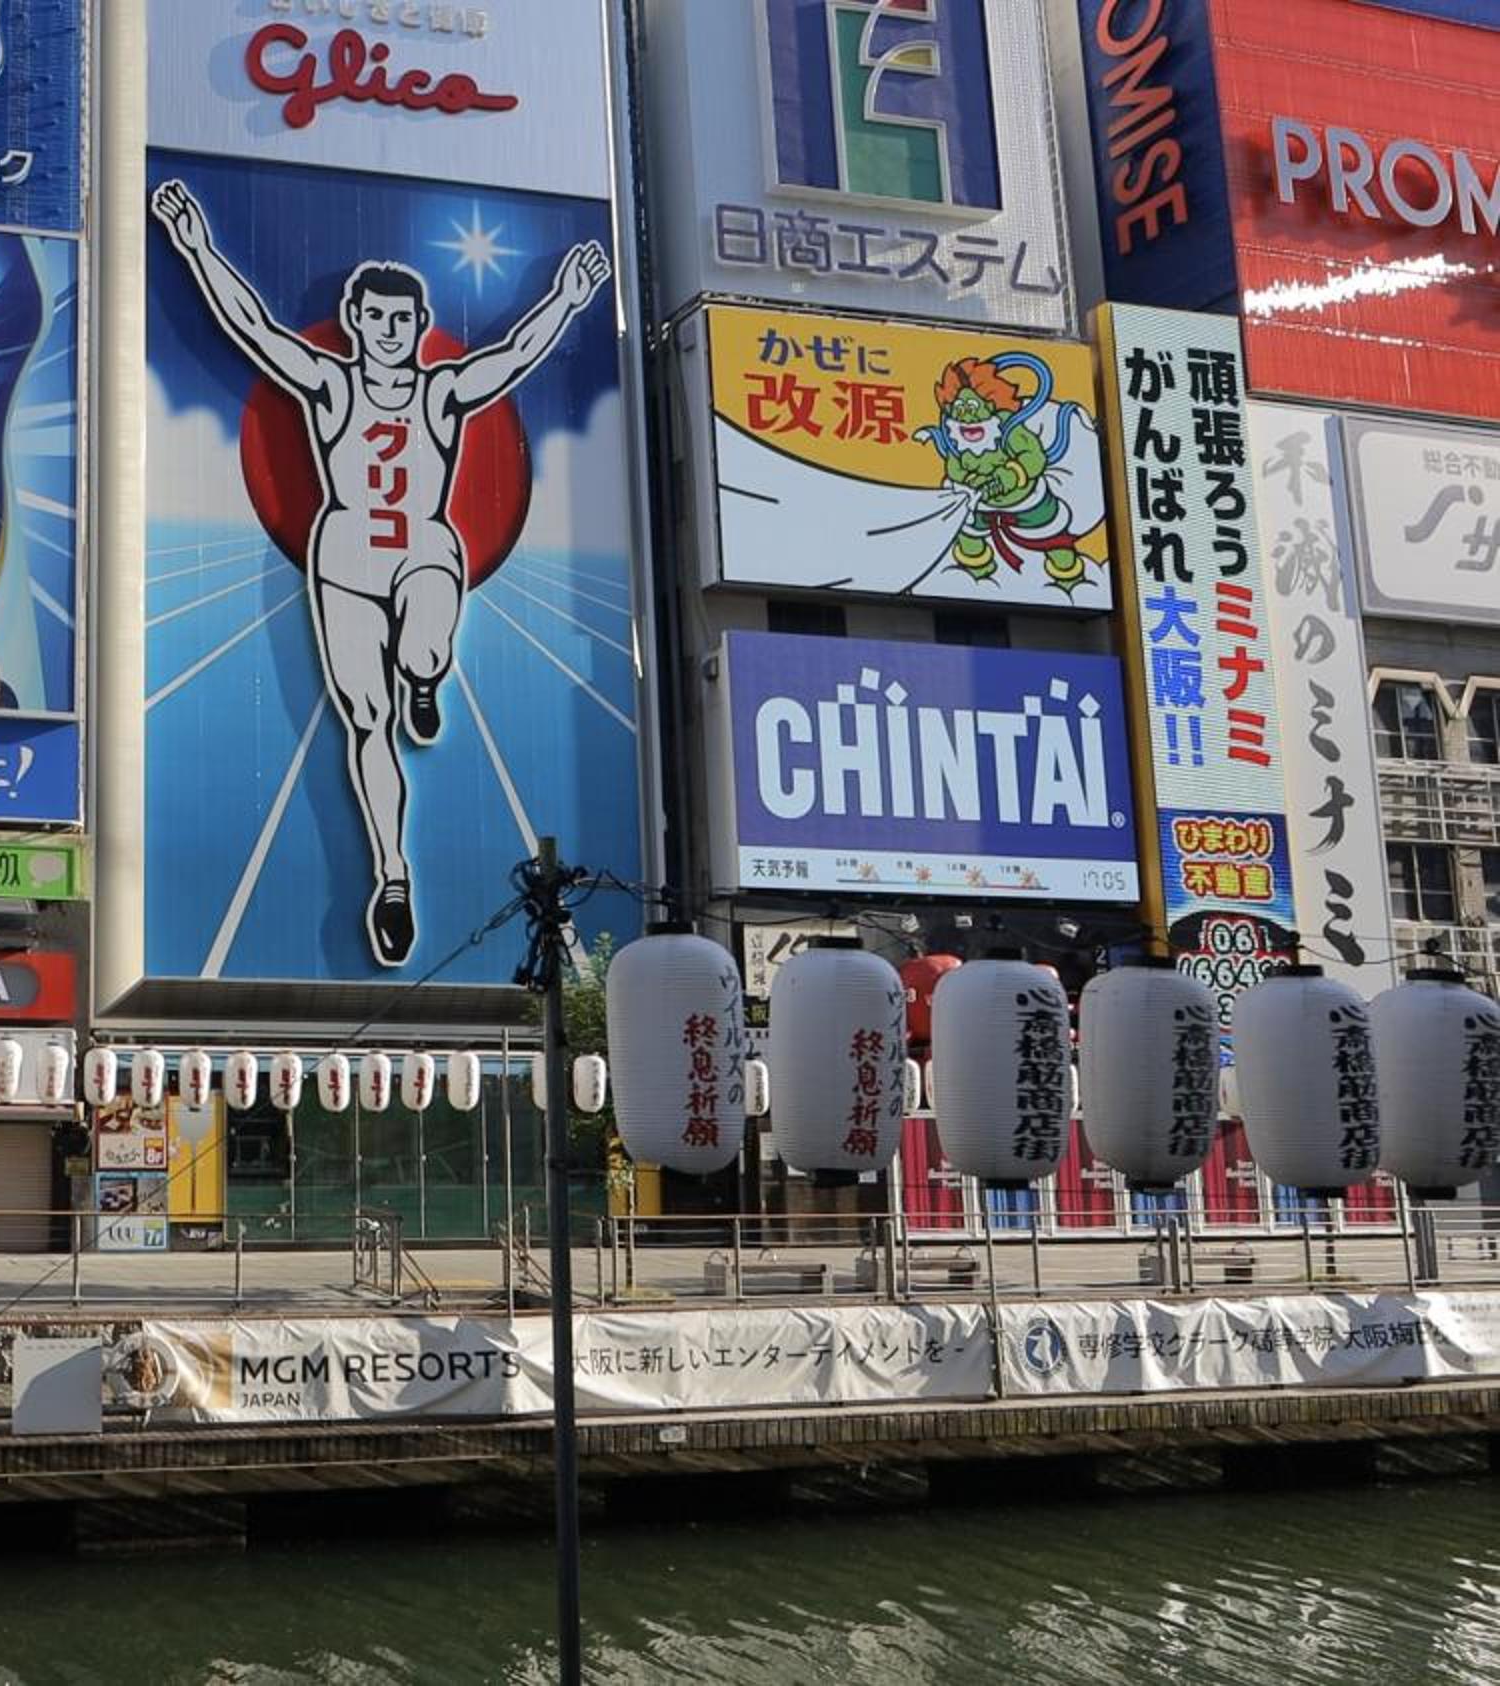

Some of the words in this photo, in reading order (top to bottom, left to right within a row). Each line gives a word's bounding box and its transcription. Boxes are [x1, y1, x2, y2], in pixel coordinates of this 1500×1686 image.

[245, 23, 519, 129] Glico
[714, 202, 1063, 297] 日商エステム
[757, 328, 891, 377] かぜに
[742, 372, 909, 446] 改源
[362, 417, 412, 550] グリコ
[1186, 347, 1272, 768] 頑張ろうミナミ
[1174, 817, 1272, 858] ひまわり
[751, 858, 810, 880] 天気予報
[1182, 861, 1274, 900] 不動産
[240, 1355, 330, 1385] MGM
[344, 1349, 521, 1384] RESORTS
[242, 1391, 301, 1407] JAPAN
